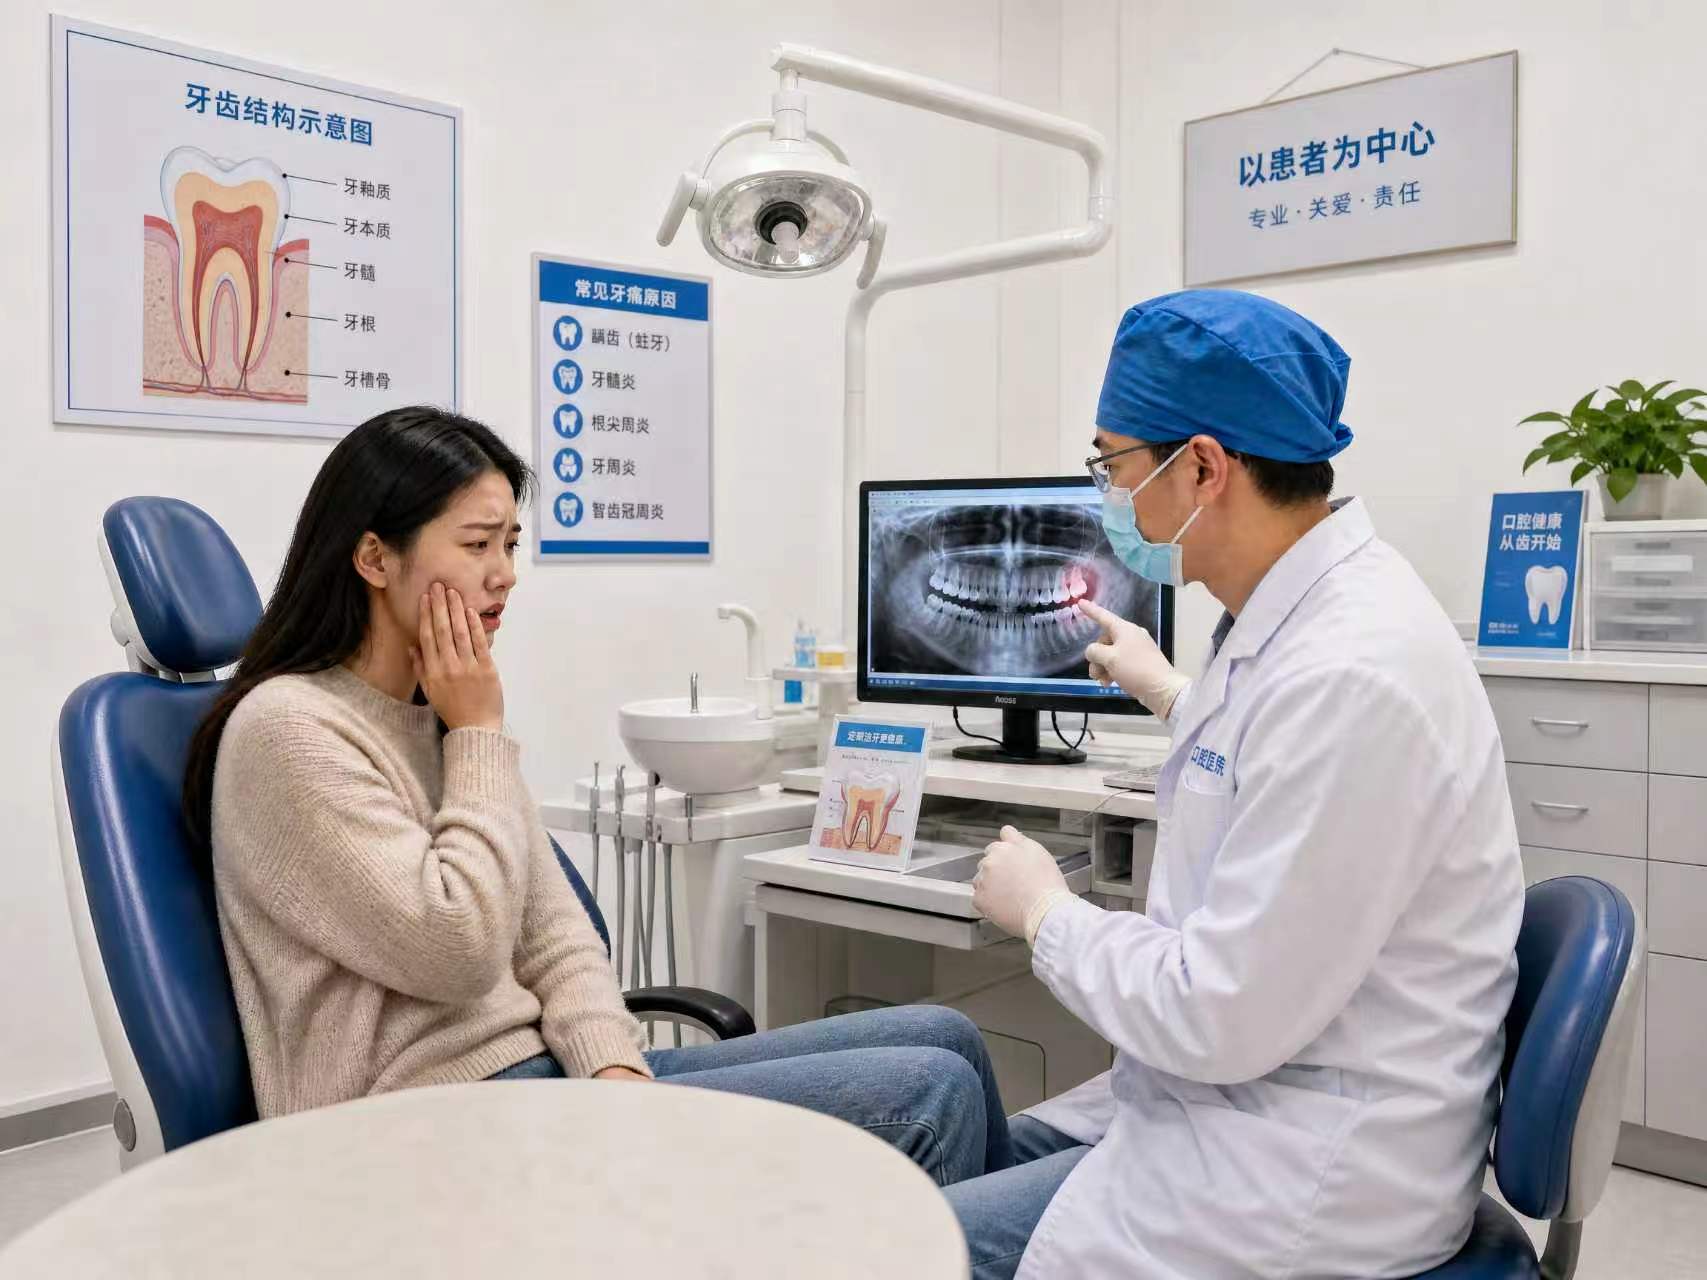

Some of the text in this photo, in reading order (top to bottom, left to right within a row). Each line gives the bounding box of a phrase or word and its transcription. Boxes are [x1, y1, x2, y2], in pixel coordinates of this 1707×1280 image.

[184, 82, 374, 147] 牙齿结构示意图
[1238, 120, 1436, 188] 以患者为中心
[344, 177, 391, 201] 牙釉质
[343, 217, 391, 240] 牙本质
[344, 262, 376, 282] 牙髓
[574, 279, 677, 309] 常见牙痛原因
[343, 313, 376, 333] 牙根
[344, 370, 391, 390] 牙槽骨
[591, 370, 636, 391] 牙髓炎
[591, 414, 650, 434] 根尖周炎
[591, 458, 636, 476] 牙周炎
[592, 501, 664, 521] 智齿冠周炎
[1502, 511, 1563, 531] 口腔健康
[1499, 533, 1562, 551] 从齿开始
